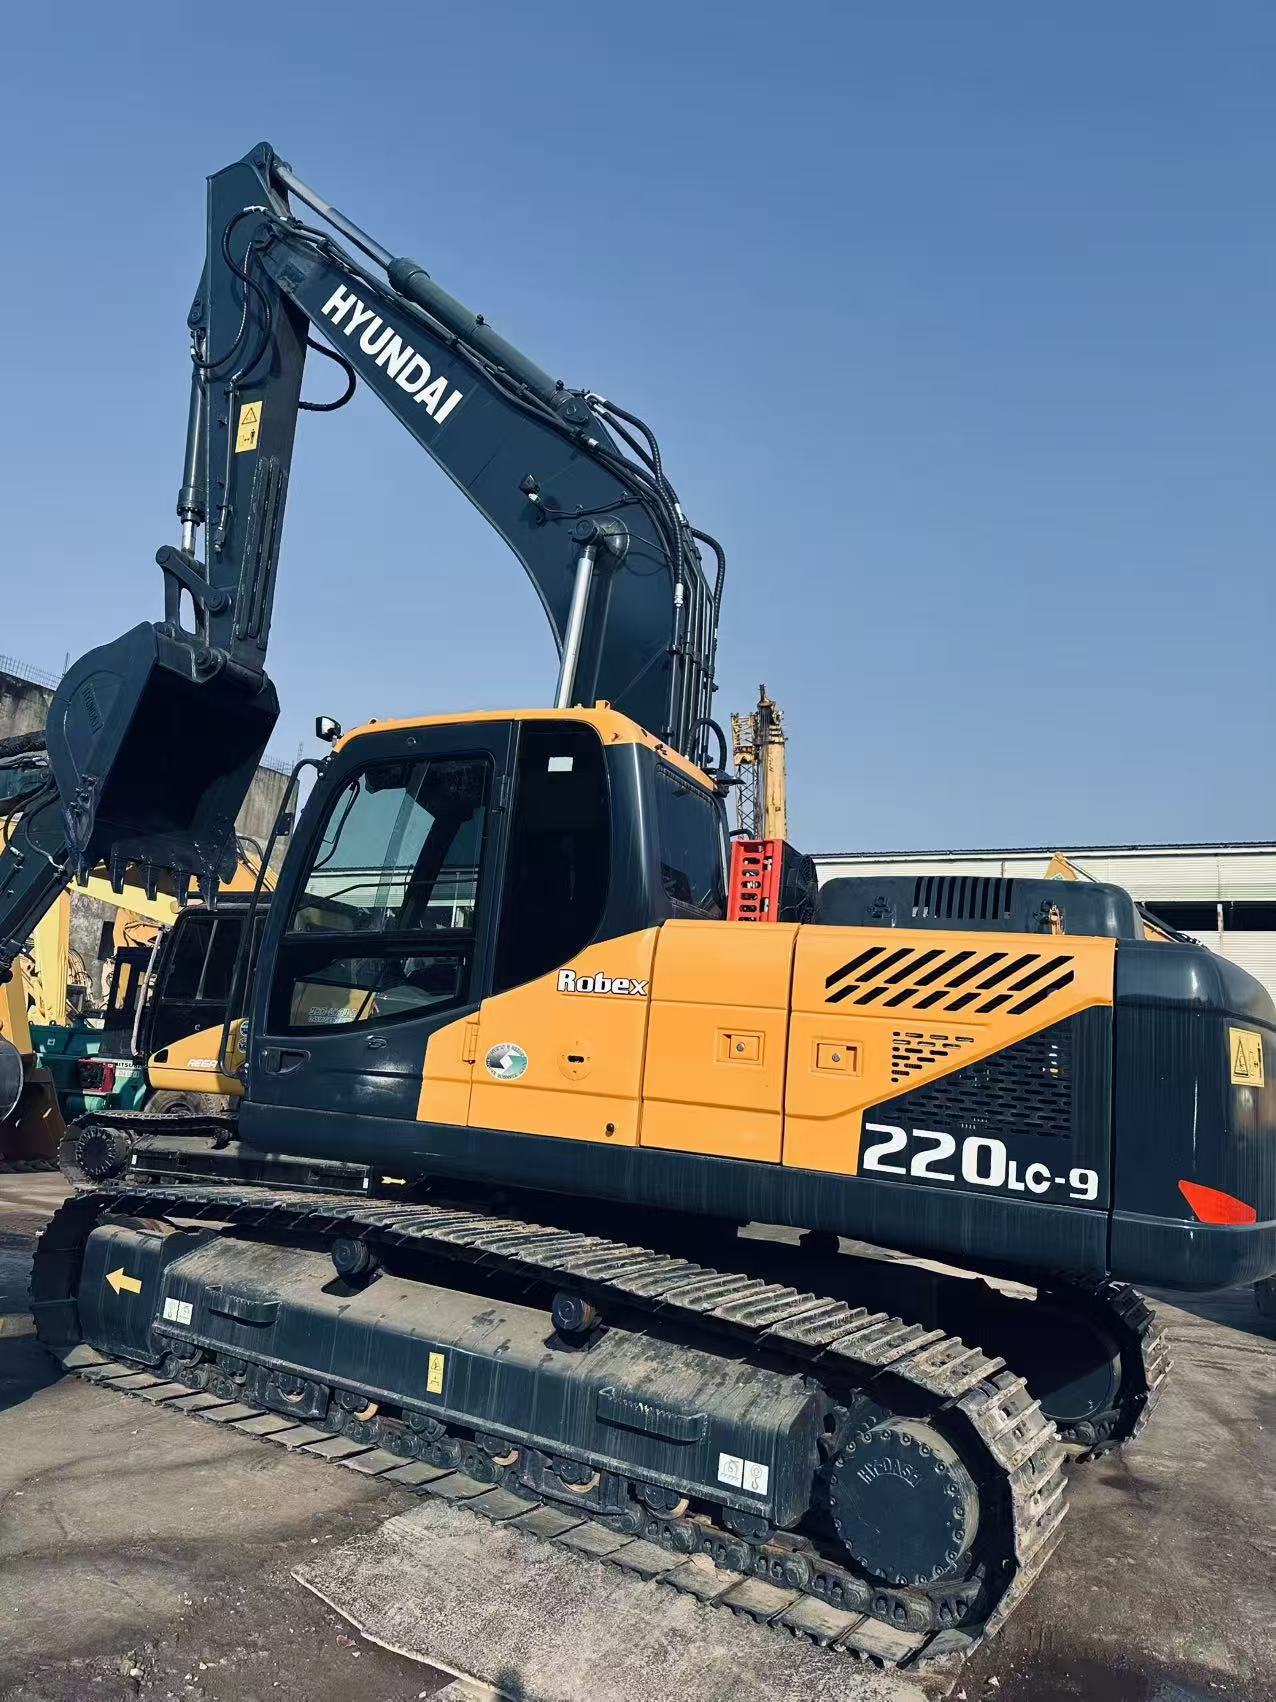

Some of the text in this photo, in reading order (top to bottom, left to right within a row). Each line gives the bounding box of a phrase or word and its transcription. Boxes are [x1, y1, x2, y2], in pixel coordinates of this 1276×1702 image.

[321, 284, 463, 424] HYUNDAI
[557, 969, 648, 995] Robex
[863, 1123, 1098, 1200] 220LC-9
